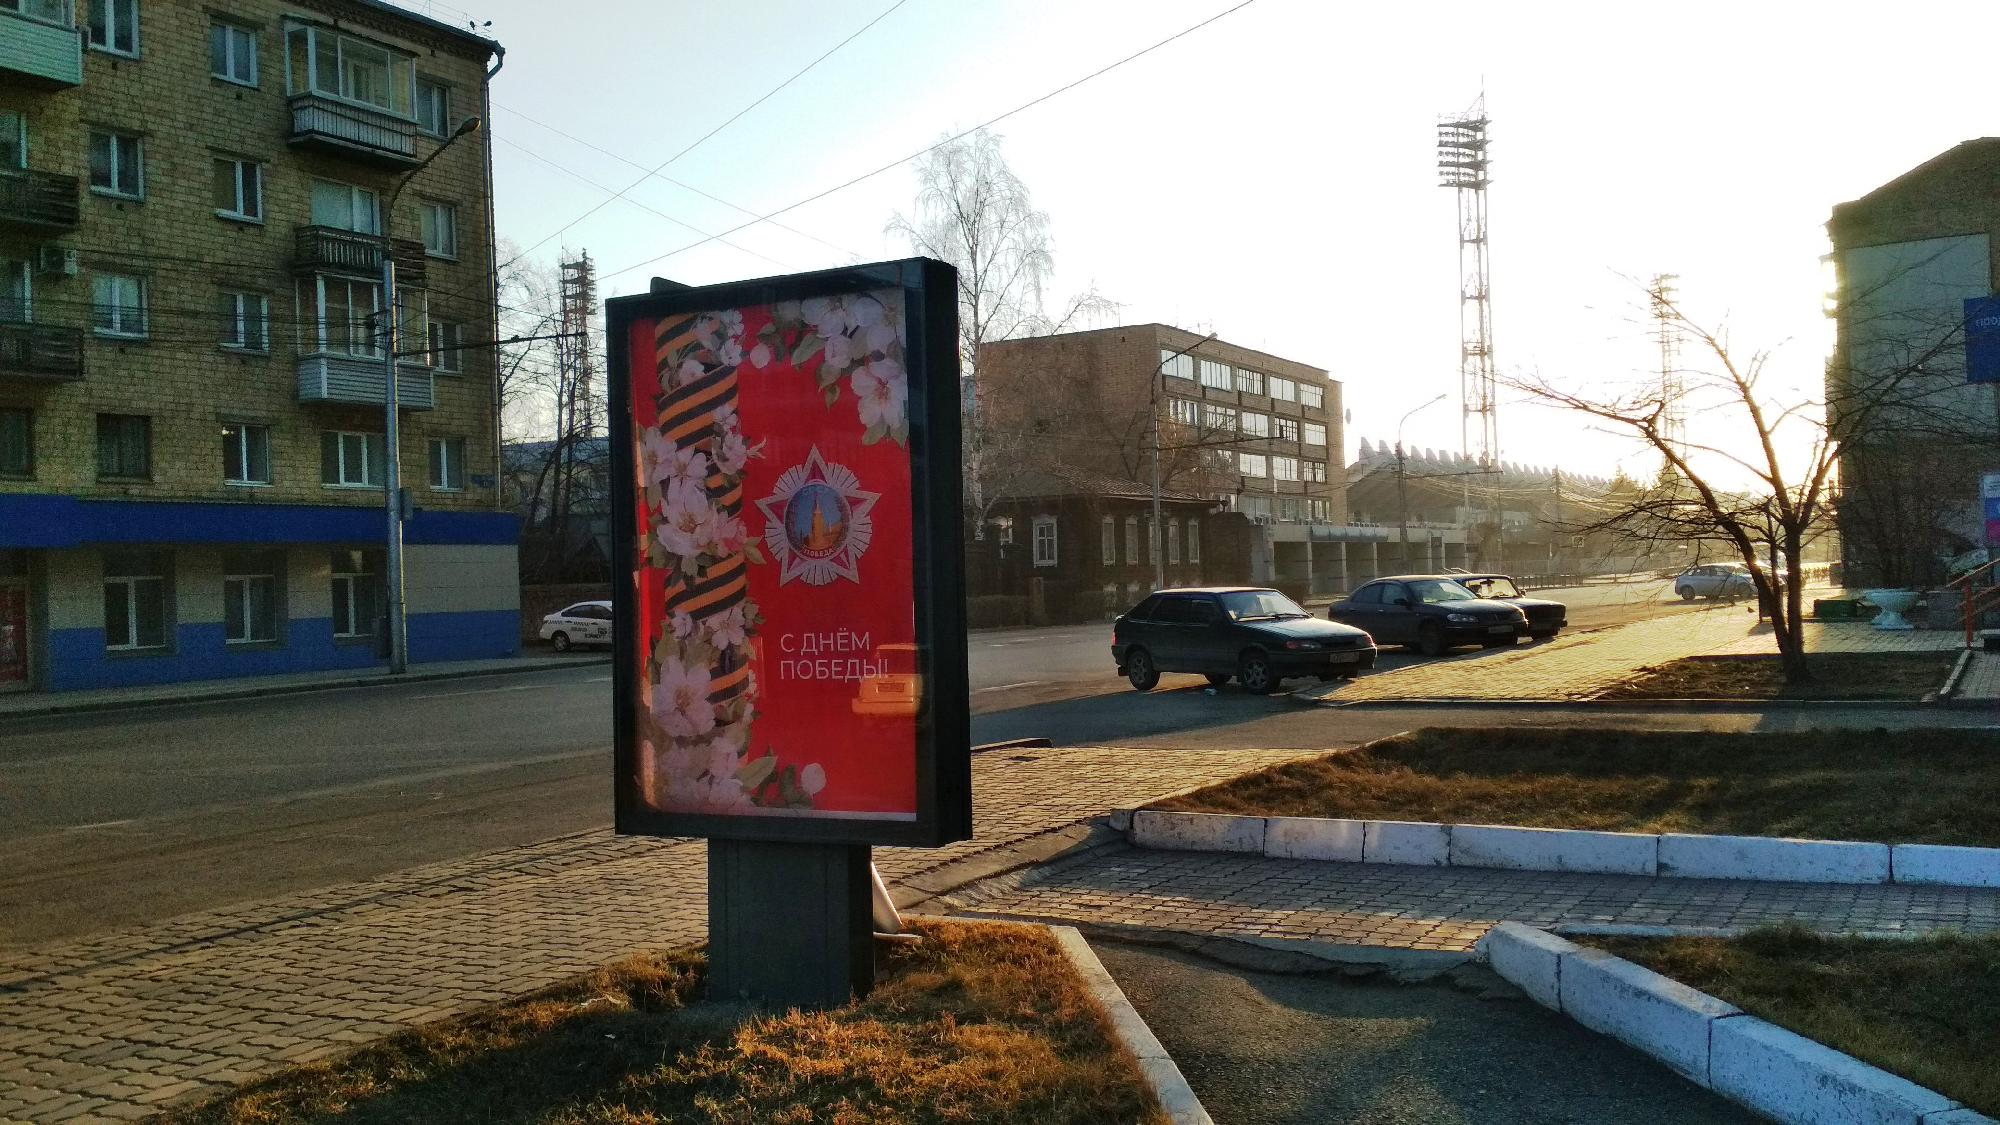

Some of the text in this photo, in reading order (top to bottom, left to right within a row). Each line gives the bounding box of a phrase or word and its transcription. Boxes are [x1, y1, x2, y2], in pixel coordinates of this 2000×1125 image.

[803, 546, 834, 557] ПОБЕДА
[780, 627, 870, 656] С ДНЁМ
[780, 658, 888, 683] ПОБЕДЫ!
